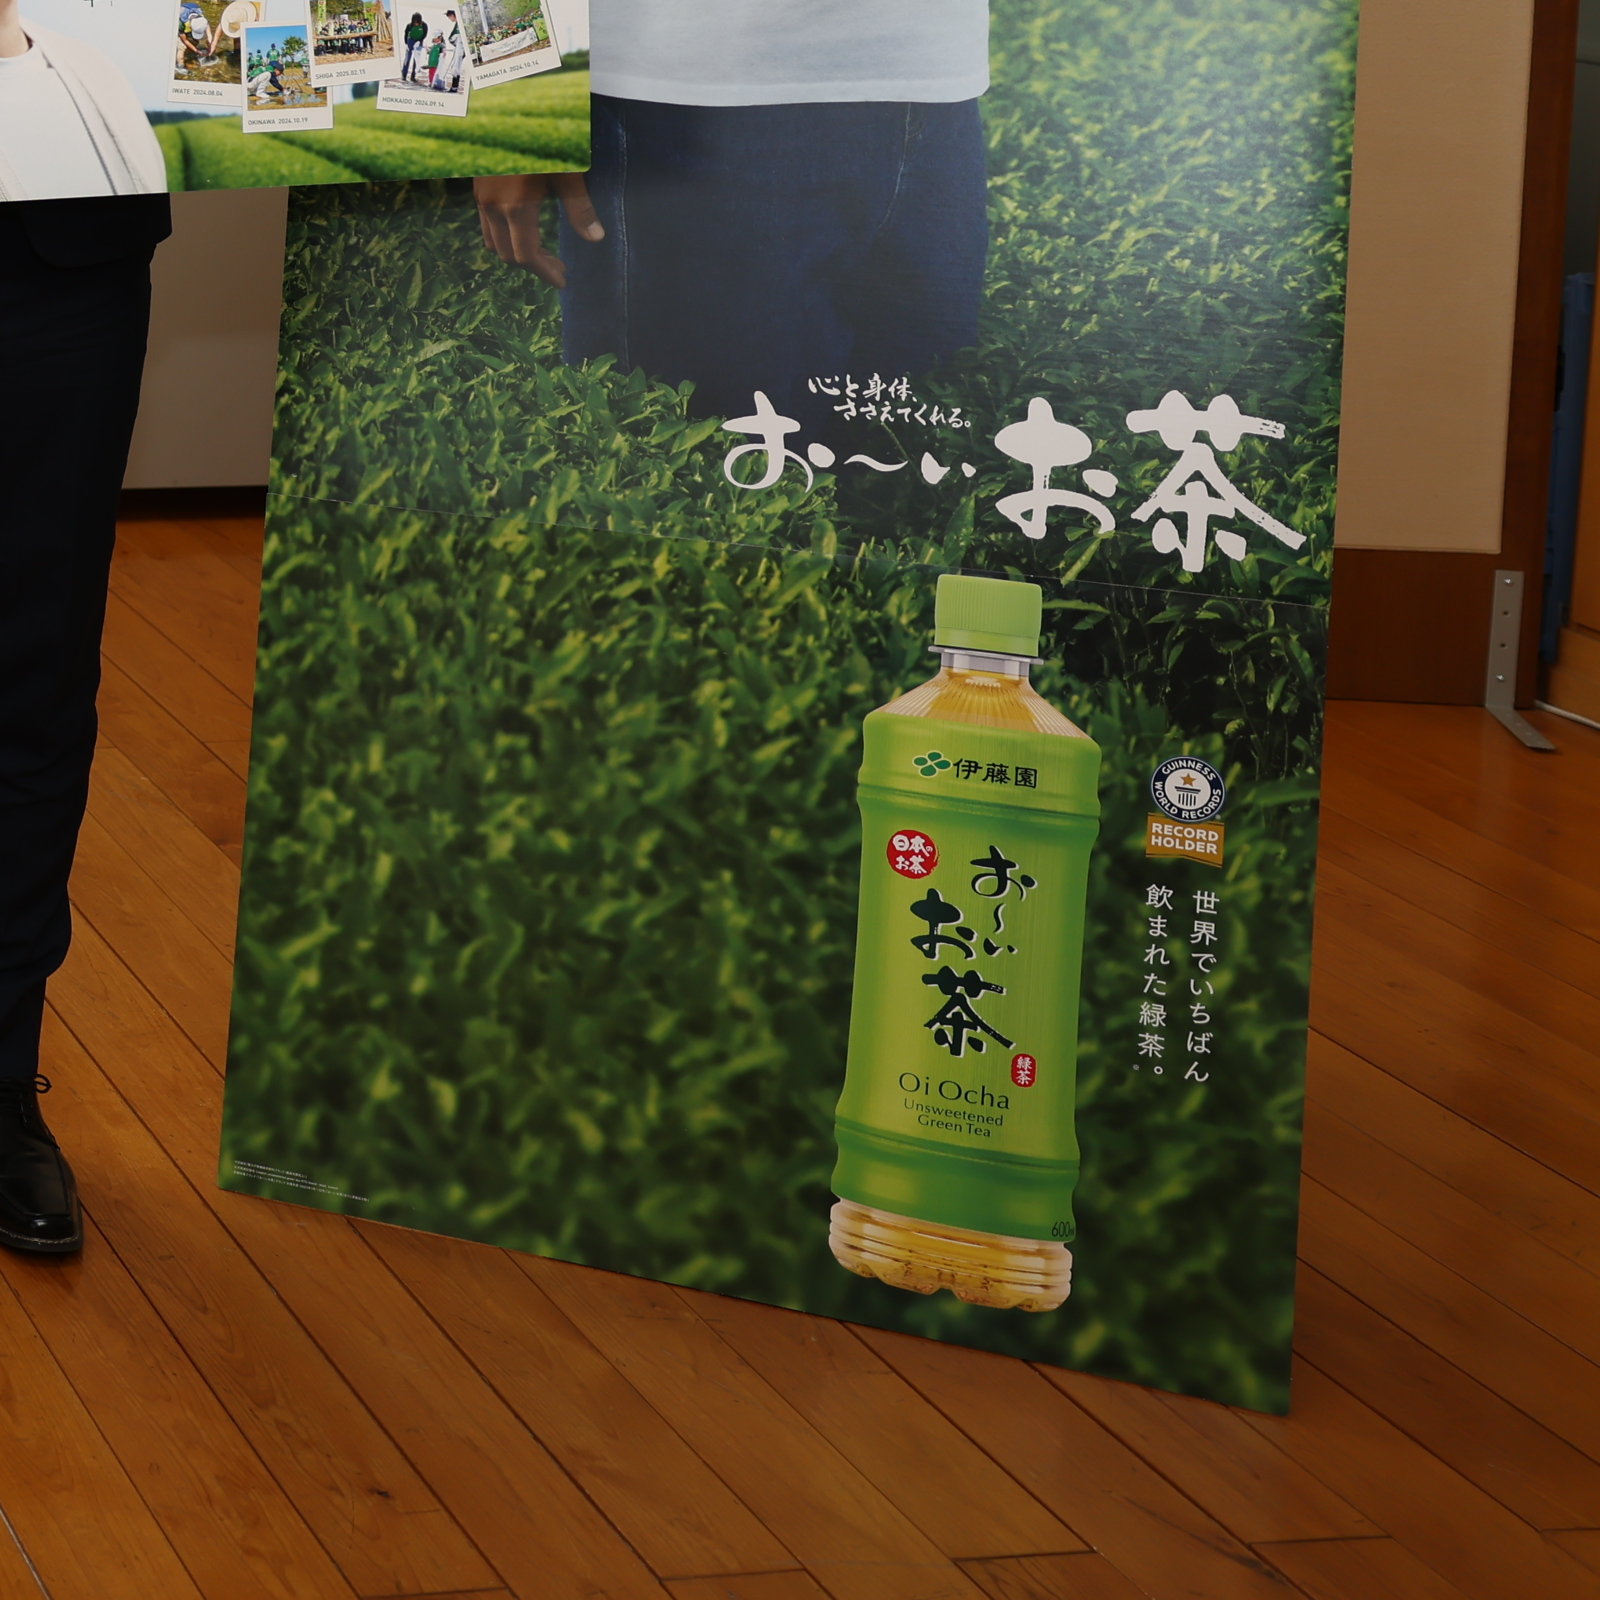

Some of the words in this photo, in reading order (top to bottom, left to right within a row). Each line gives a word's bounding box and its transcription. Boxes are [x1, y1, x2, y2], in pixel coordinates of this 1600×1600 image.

[172, 88, 191, 96] IWATE
[247, 118, 276, 126] OKINAWA
[808, 373, 918, 403] 心と身体、
[833, 398, 971, 428] ささえてくれる。
[952, 756, 1039, 790] 伊藤園
[1161, 759, 1217, 781] GUINNESS
[1154, 781, 1178, 815] WORLD
[1181, 788, 1222, 820] RECORDS
[1151, 822, 1220, 842] RECORD
[1151, 835, 1218, 855] HOLDER
[910, 888, 1017, 1058] お茶
[1184, 889, 1221, 1083] 世界でいちばん
[1016, 1056, 1033, 1086] 緑茶
[899, 1072, 930, 1096] Oi
[938, 1080, 1010, 1110] Ocha
[904, 1097, 1004, 1127] Unsweetened
[917, 1114, 963, 1133] Green
[966, 1122, 992, 1137] Tea
